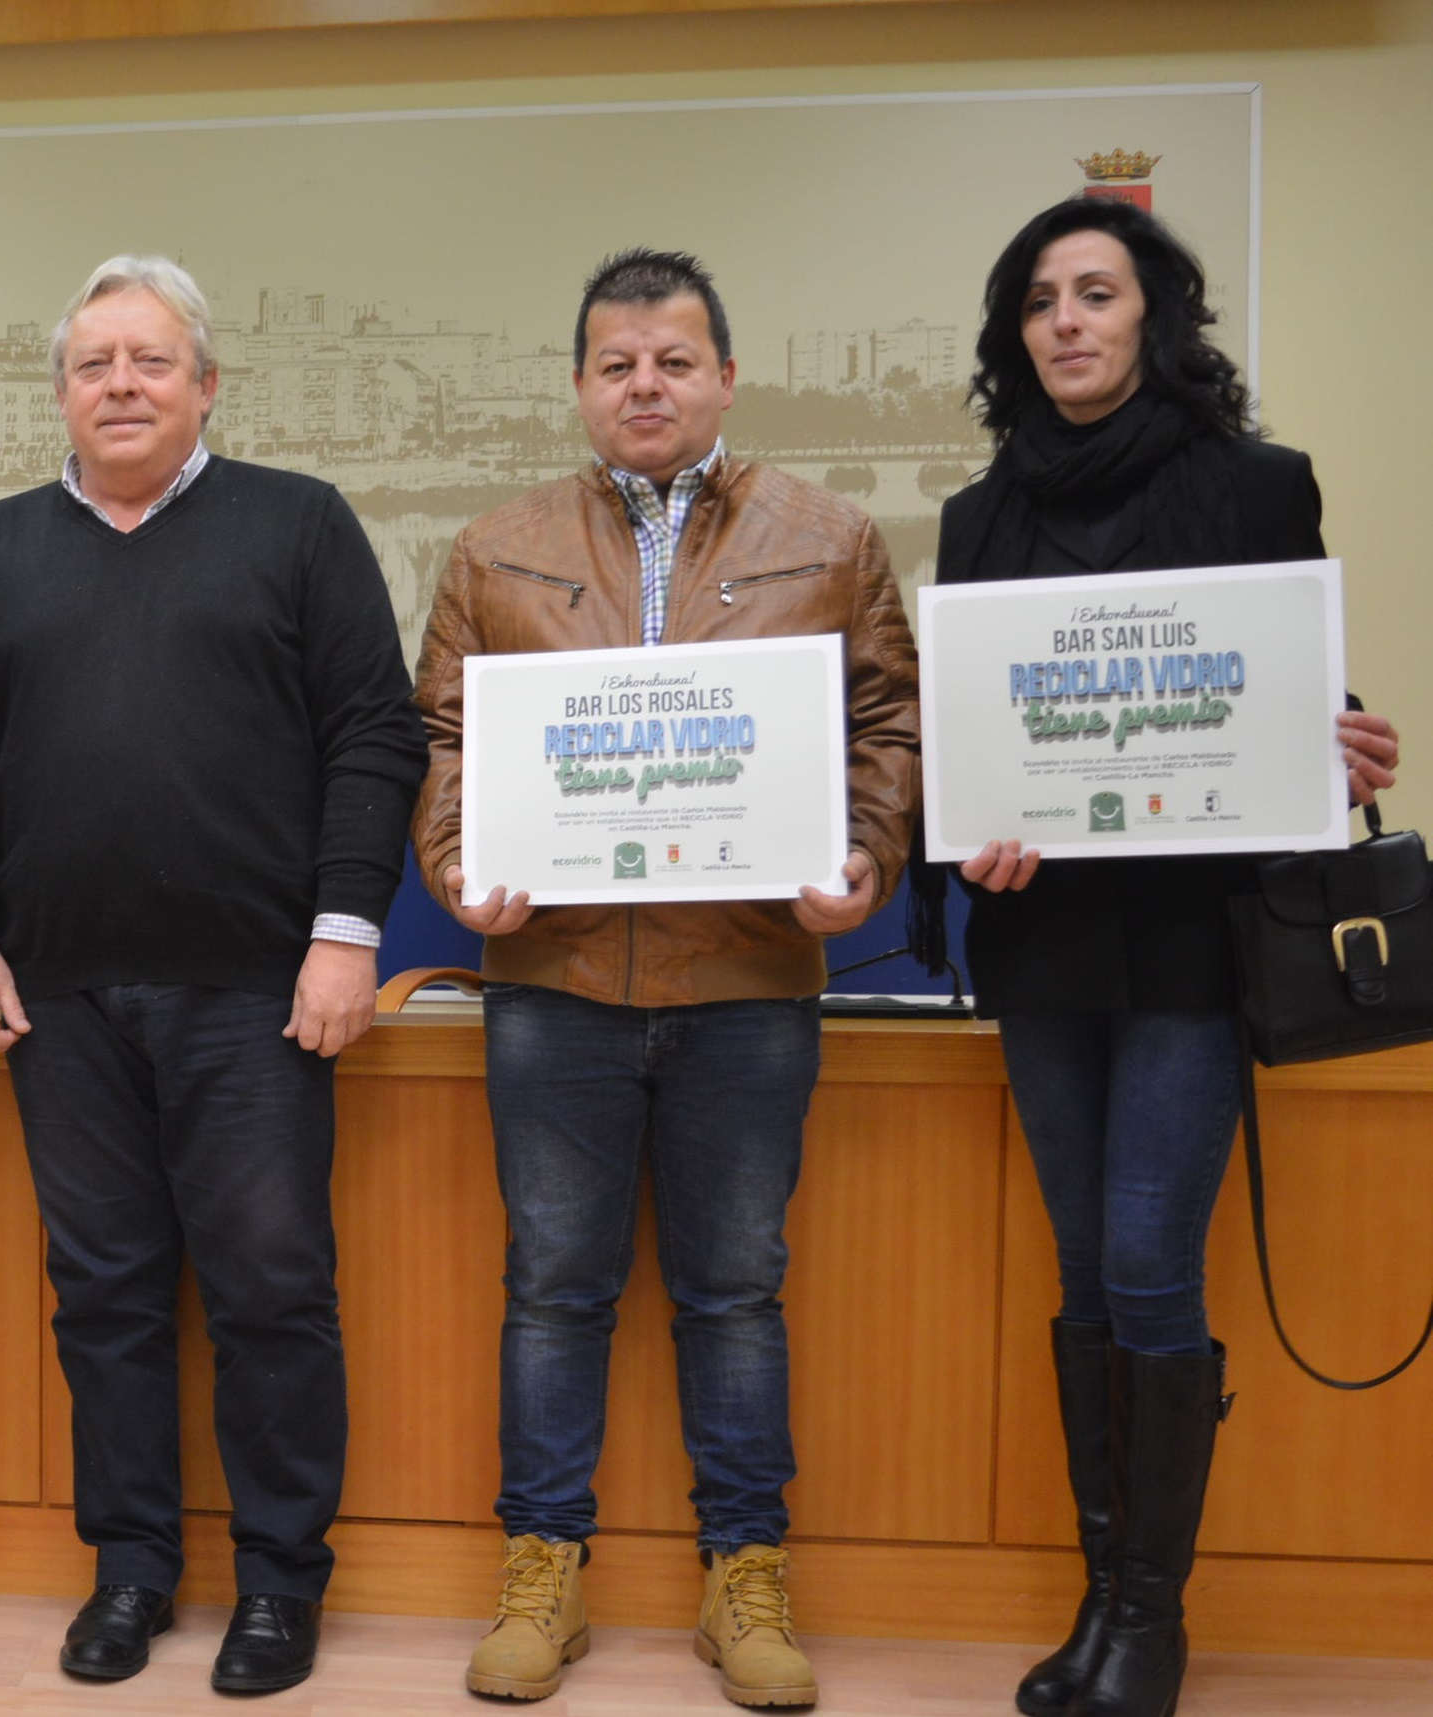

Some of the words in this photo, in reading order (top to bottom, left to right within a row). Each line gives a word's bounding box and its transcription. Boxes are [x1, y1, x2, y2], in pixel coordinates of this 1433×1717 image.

[1070, 601, 1177, 623] ¡Enhorabuena!
[1053, 628, 1095, 654] BAR
[1101, 625, 1143, 650] SAN
[1150, 621, 1197, 647] LUIS
[600, 670, 695, 690] ¡Enhorabuena!
[1009, 657, 1143, 706] RECICLAR
[1149, 651, 1245, 699] VIDRIO
[565, 695, 601, 717] BAR
[608, 693, 642, 714] LOS
[648, 687, 733, 712] ROSALES
[1022, 695, 1109, 743] tiene
[1111, 690, 1232, 752] premio
[544, 719, 664, 763] RECICLAR
[670, 714, 755, 757] VIDRIO
[555, 752, 633, 796] tiene
[635, 747, 743, 804] premio
[1021, 805, 1076, 819] ecovidrio
[552, 854, 601, 866] ecovidrio
